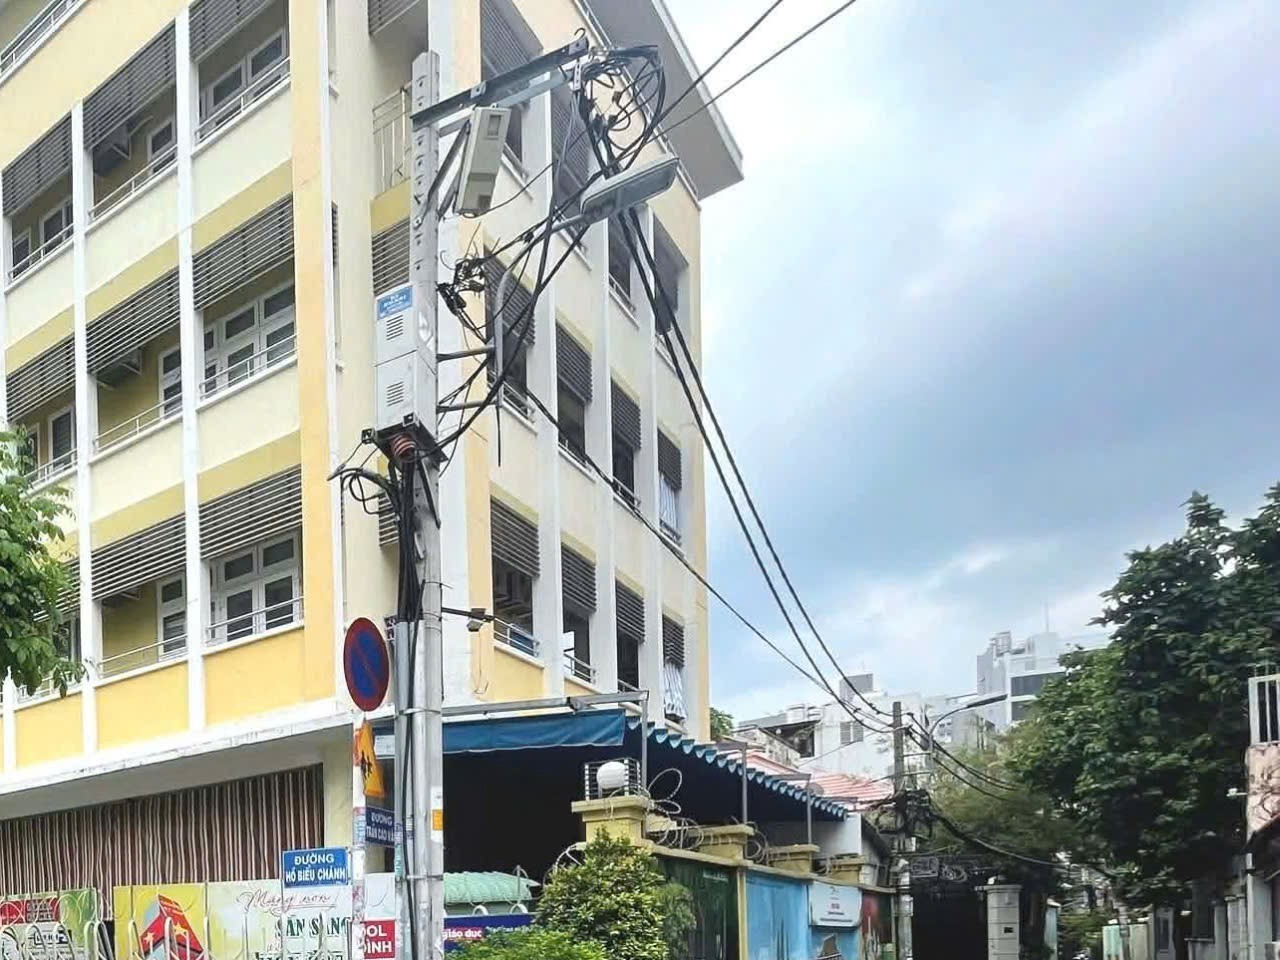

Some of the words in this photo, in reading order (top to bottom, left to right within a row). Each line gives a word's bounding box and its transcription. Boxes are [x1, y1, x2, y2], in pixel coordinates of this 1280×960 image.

[294, 852, 334, 866] ĐƯỜNG
[285, 866, 297, 882] HỒ
[298, 864, 315, 881] BIỂU
[317, 866, 346, 881] CHÁNH
